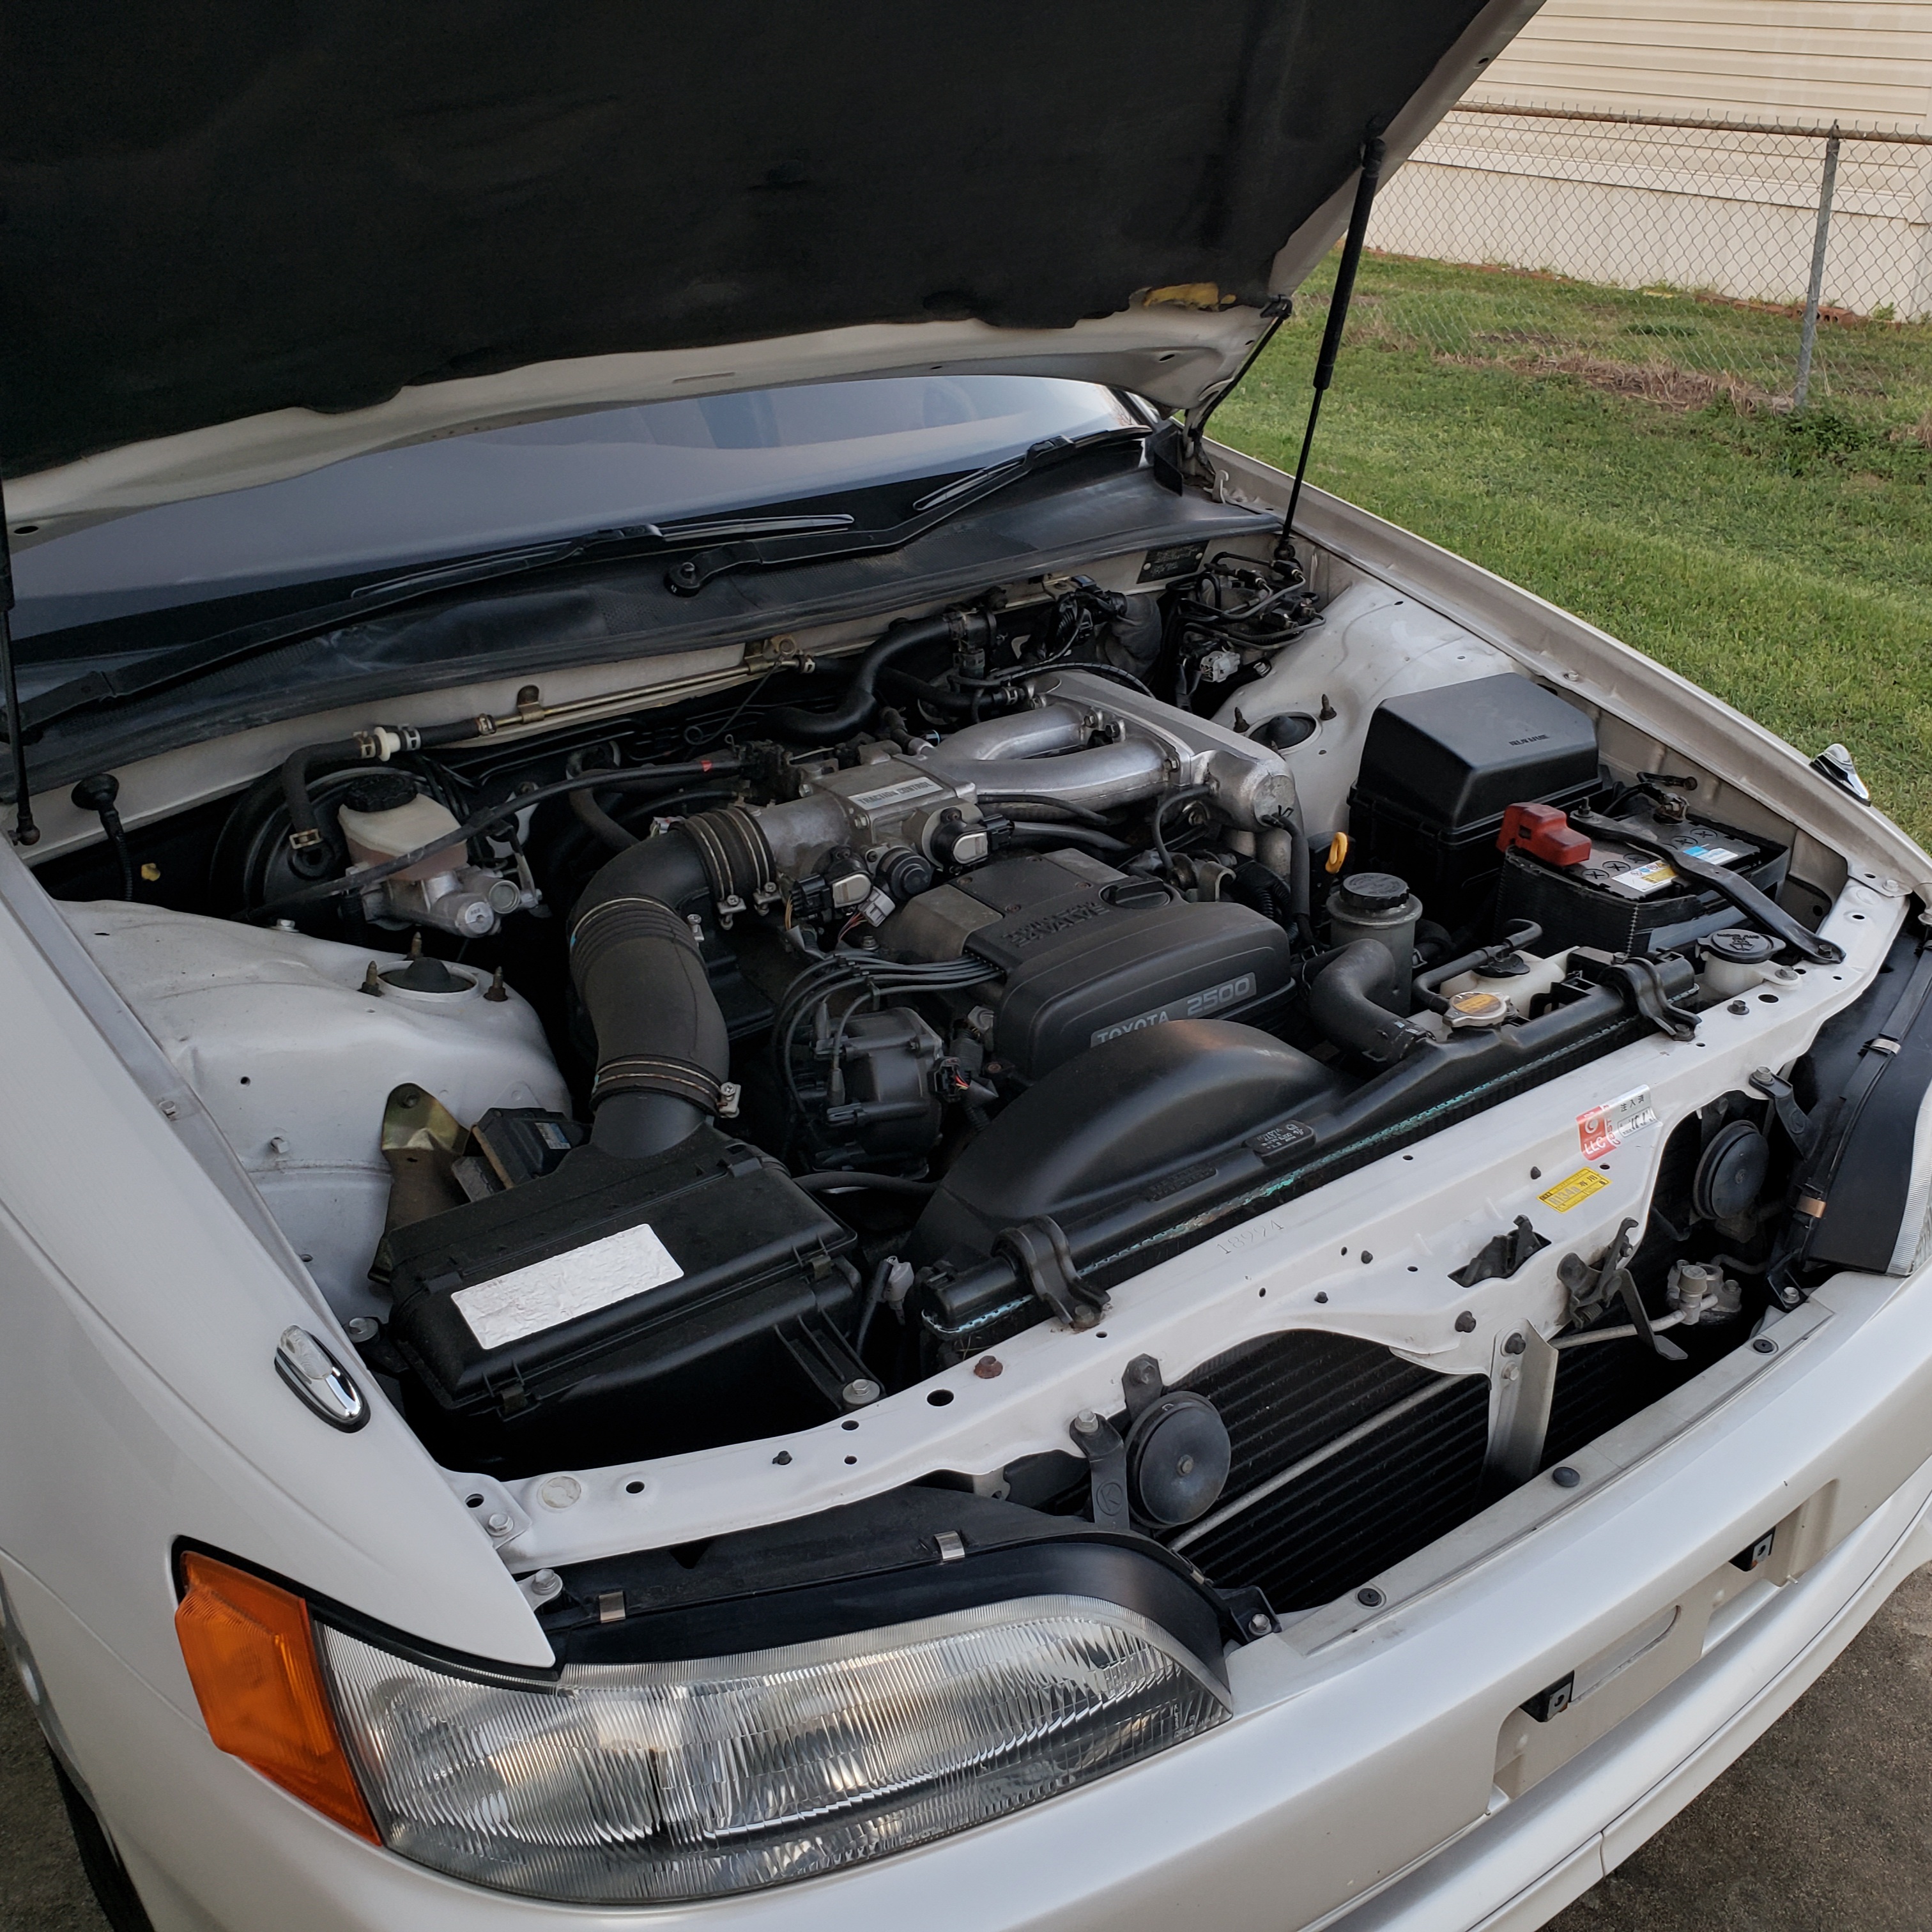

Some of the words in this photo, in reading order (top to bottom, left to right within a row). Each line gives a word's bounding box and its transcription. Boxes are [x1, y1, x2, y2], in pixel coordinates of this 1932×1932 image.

[857, 790, 899, 804] TRACTION
[896, 781, 934, 794] CONTROL
[1097, 1011, 1169, 1043] TOYOTA
[1187, 977, 1250, 1016] 2500
[1584, 1136, 1606, 1155] LLC
[1217, 1220, 1284, 1254] 18994
